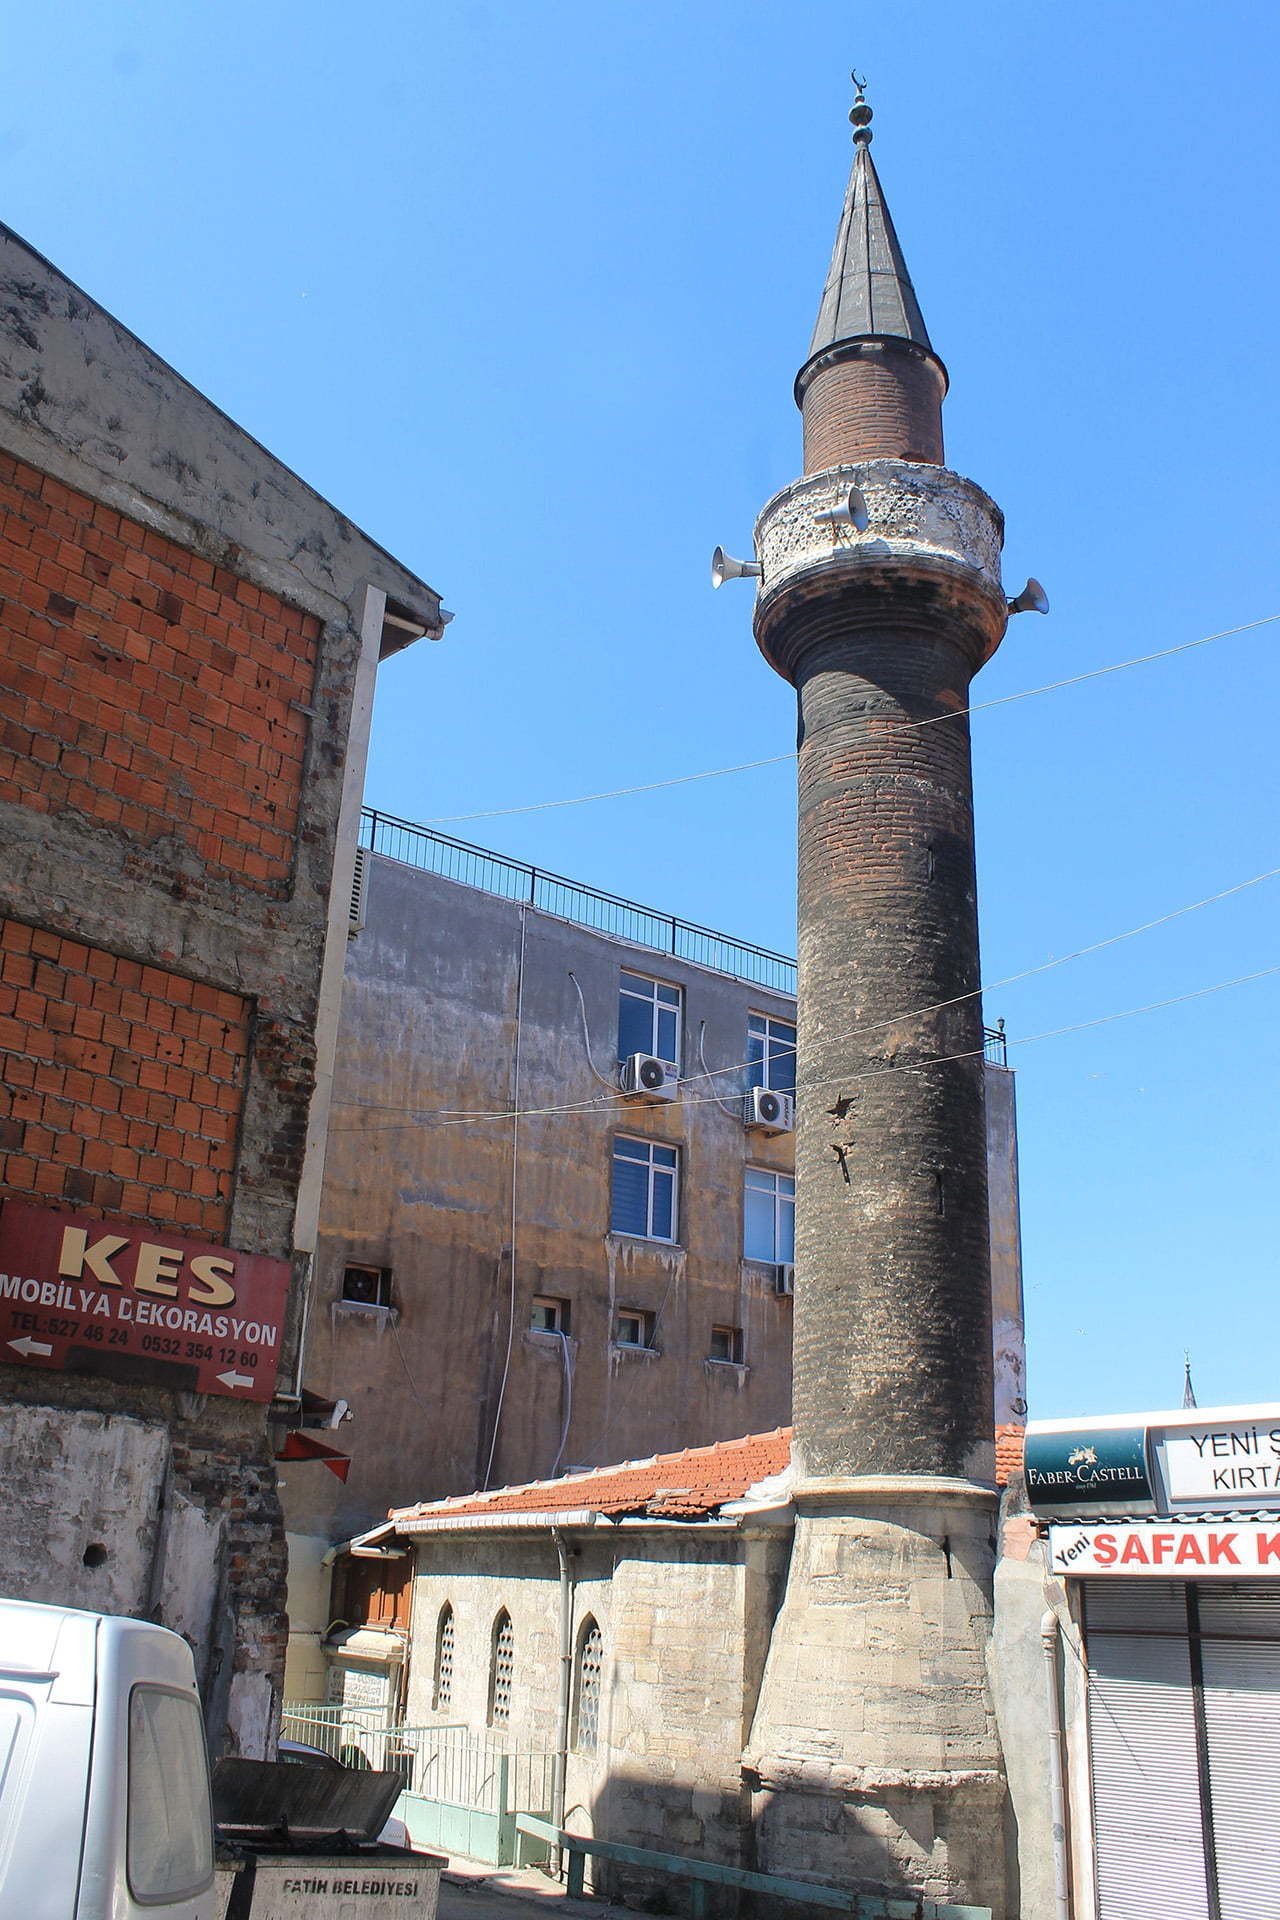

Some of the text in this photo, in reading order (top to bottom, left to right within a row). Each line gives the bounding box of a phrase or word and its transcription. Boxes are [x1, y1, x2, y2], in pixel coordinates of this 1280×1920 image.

[58, 1225, 236, 1305] KES
[0, 1274, 277, 1347] MOBİLYA DEKORASYON
[108, 1328, 129, 1346] 24
[142, 1334, 258, 1368] 0532 354 12 60
[1190, 1426, 1259, 1458] YENİ
[1055, 1532, 1091, 1568] Yeni
[1093, 1533, 1241, 1568] ŞAFAK
